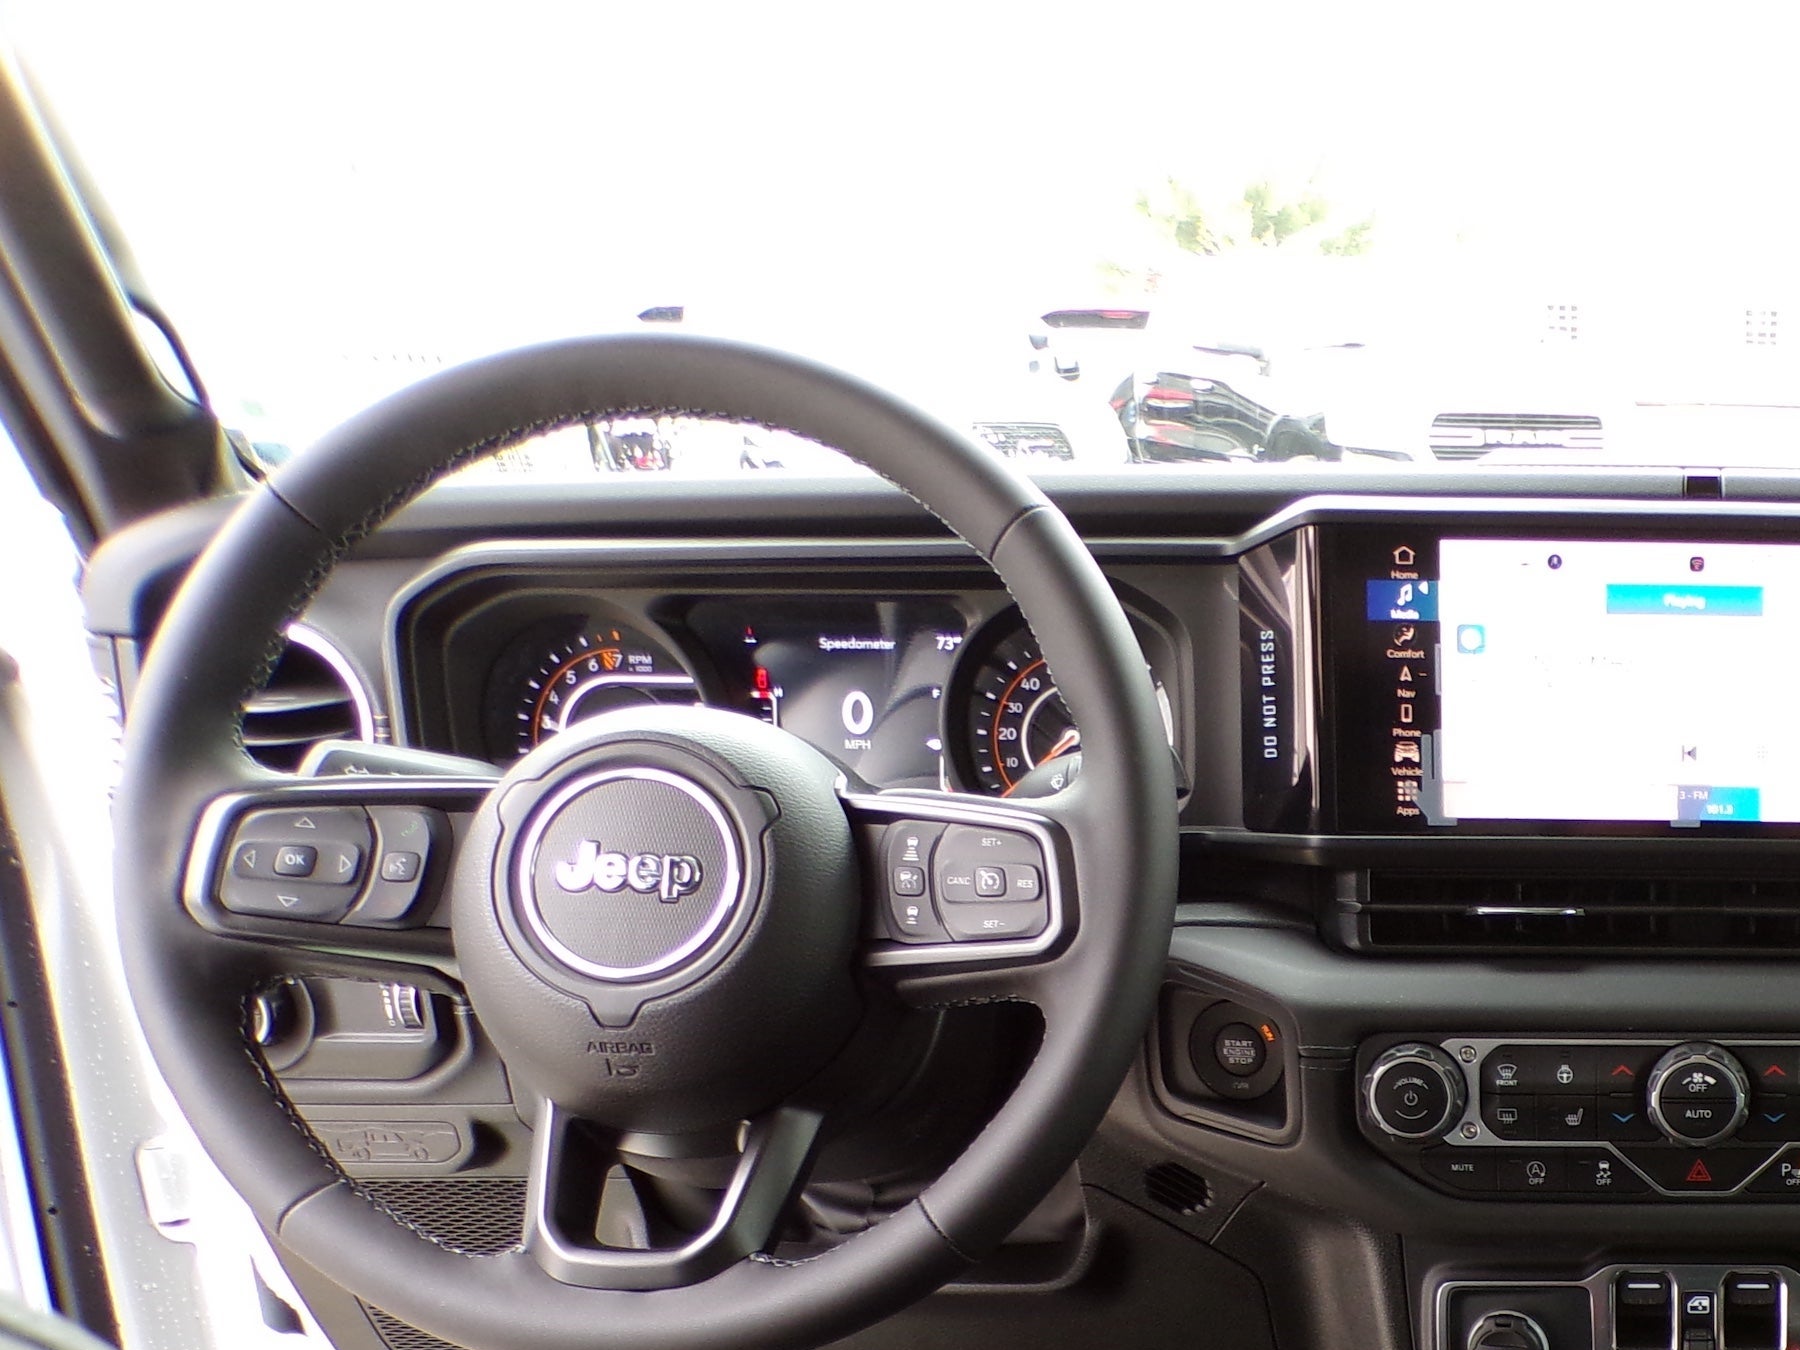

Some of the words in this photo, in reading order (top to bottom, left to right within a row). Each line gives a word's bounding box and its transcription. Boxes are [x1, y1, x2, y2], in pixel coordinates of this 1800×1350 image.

[1390, 570, 1419, 579] Home
[818, 636, 896, 652] Speedometer
[1260, 629, 1276, 687] PRESS
[1386, 648, 1425, 659] Comfort
[588, 659, 599, 672] 6
[613, 654, 623, 668] 7
[628, 655, 653, 665] RPM
[566, 671, 577, 685] 5
[1020, 677, 1040, 691] 40
[549, 690, 559, 704] 4
[1397, 689, 1416, 698] Nav
[842, 690, 874, 735] 0
[1007, 702, 1023, 714] 30
[1262, 695, 1277, 727] NOT
[998, 727, 1017, 741] 20
[1392, 728, 1422, 737] Phone
[844, 739, 871, 750] MPH
[1263, 735, 1278, 758] DO
[1006, 757, 1019, 768] 10
[1391, 766, 1424, 776] Vehicle
[1693, 791, 1709, 800] FM
[1396, 806, 1420, 817] Apps
[285, 853, 305, 866] OK
[555, 838, 704, 904] Jeep
[1016, 879, 1033, 888] RES
[586, 1041, 656, 1055] AIRBAG
[1223, 1047, 1256, 1056] ENGINE
[1396, 1076, 1425, 1087] VOLUME
[1496, 1079, 1518, 1087] FRONT
[1688, 1083, 1708, 1093] OFF
[1685, 1109, 1712, 1119] AUTO
[1451, 1164, 1474, 1172] MUTE
[1529, 1177, 1544, 1185] OFF
[1596, 1178, 1612, 1186] OFF
